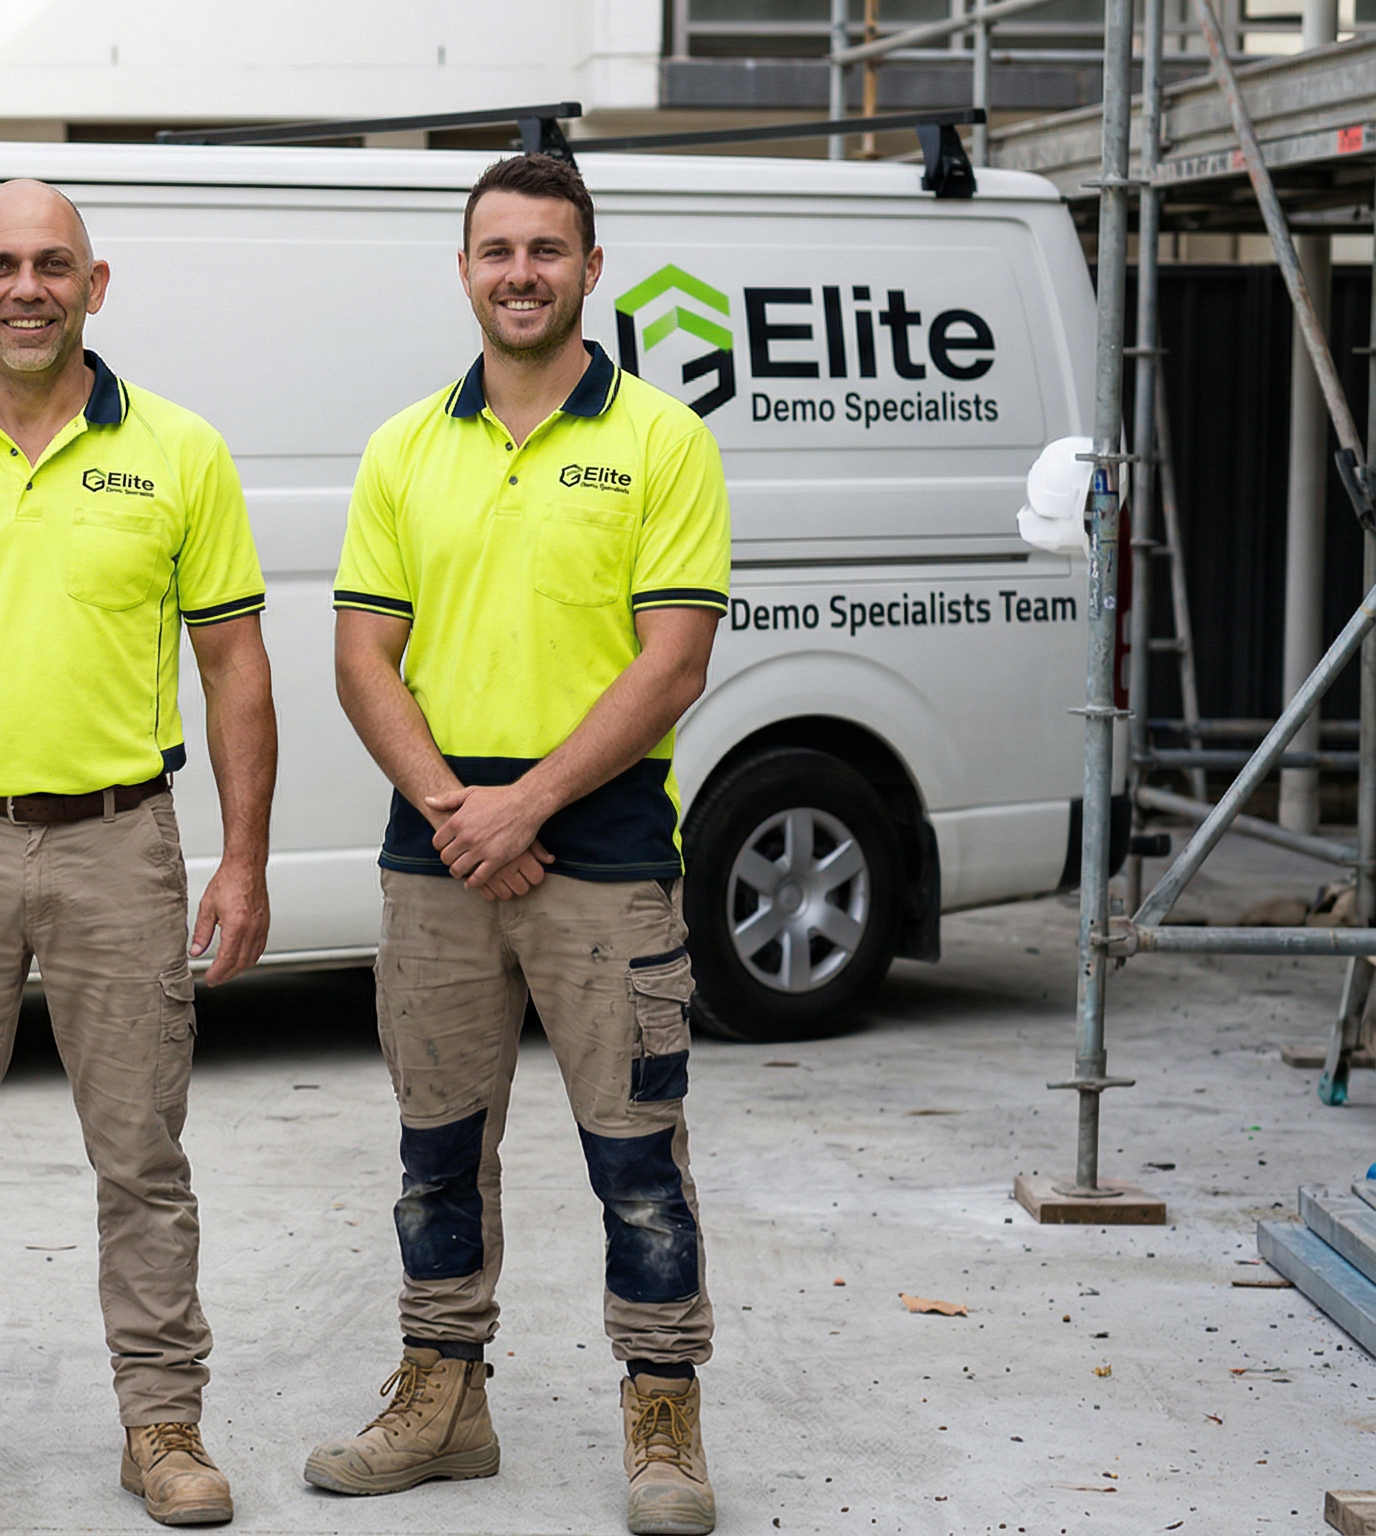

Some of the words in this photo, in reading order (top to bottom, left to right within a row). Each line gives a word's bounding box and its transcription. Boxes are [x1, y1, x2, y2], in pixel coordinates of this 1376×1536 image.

[743, 285, 996, 381] Elite
[751, 392, 835, 422] Demo
[845, 391, 999, 429] Specialists
[107, 472, 155, 491] Elite
[583, 467, 632, 486] Elite
[731, 598, 820, 631] Demo
[829, 592, 991, 636] Specialists
[999, 590, 1077, 623] Team
